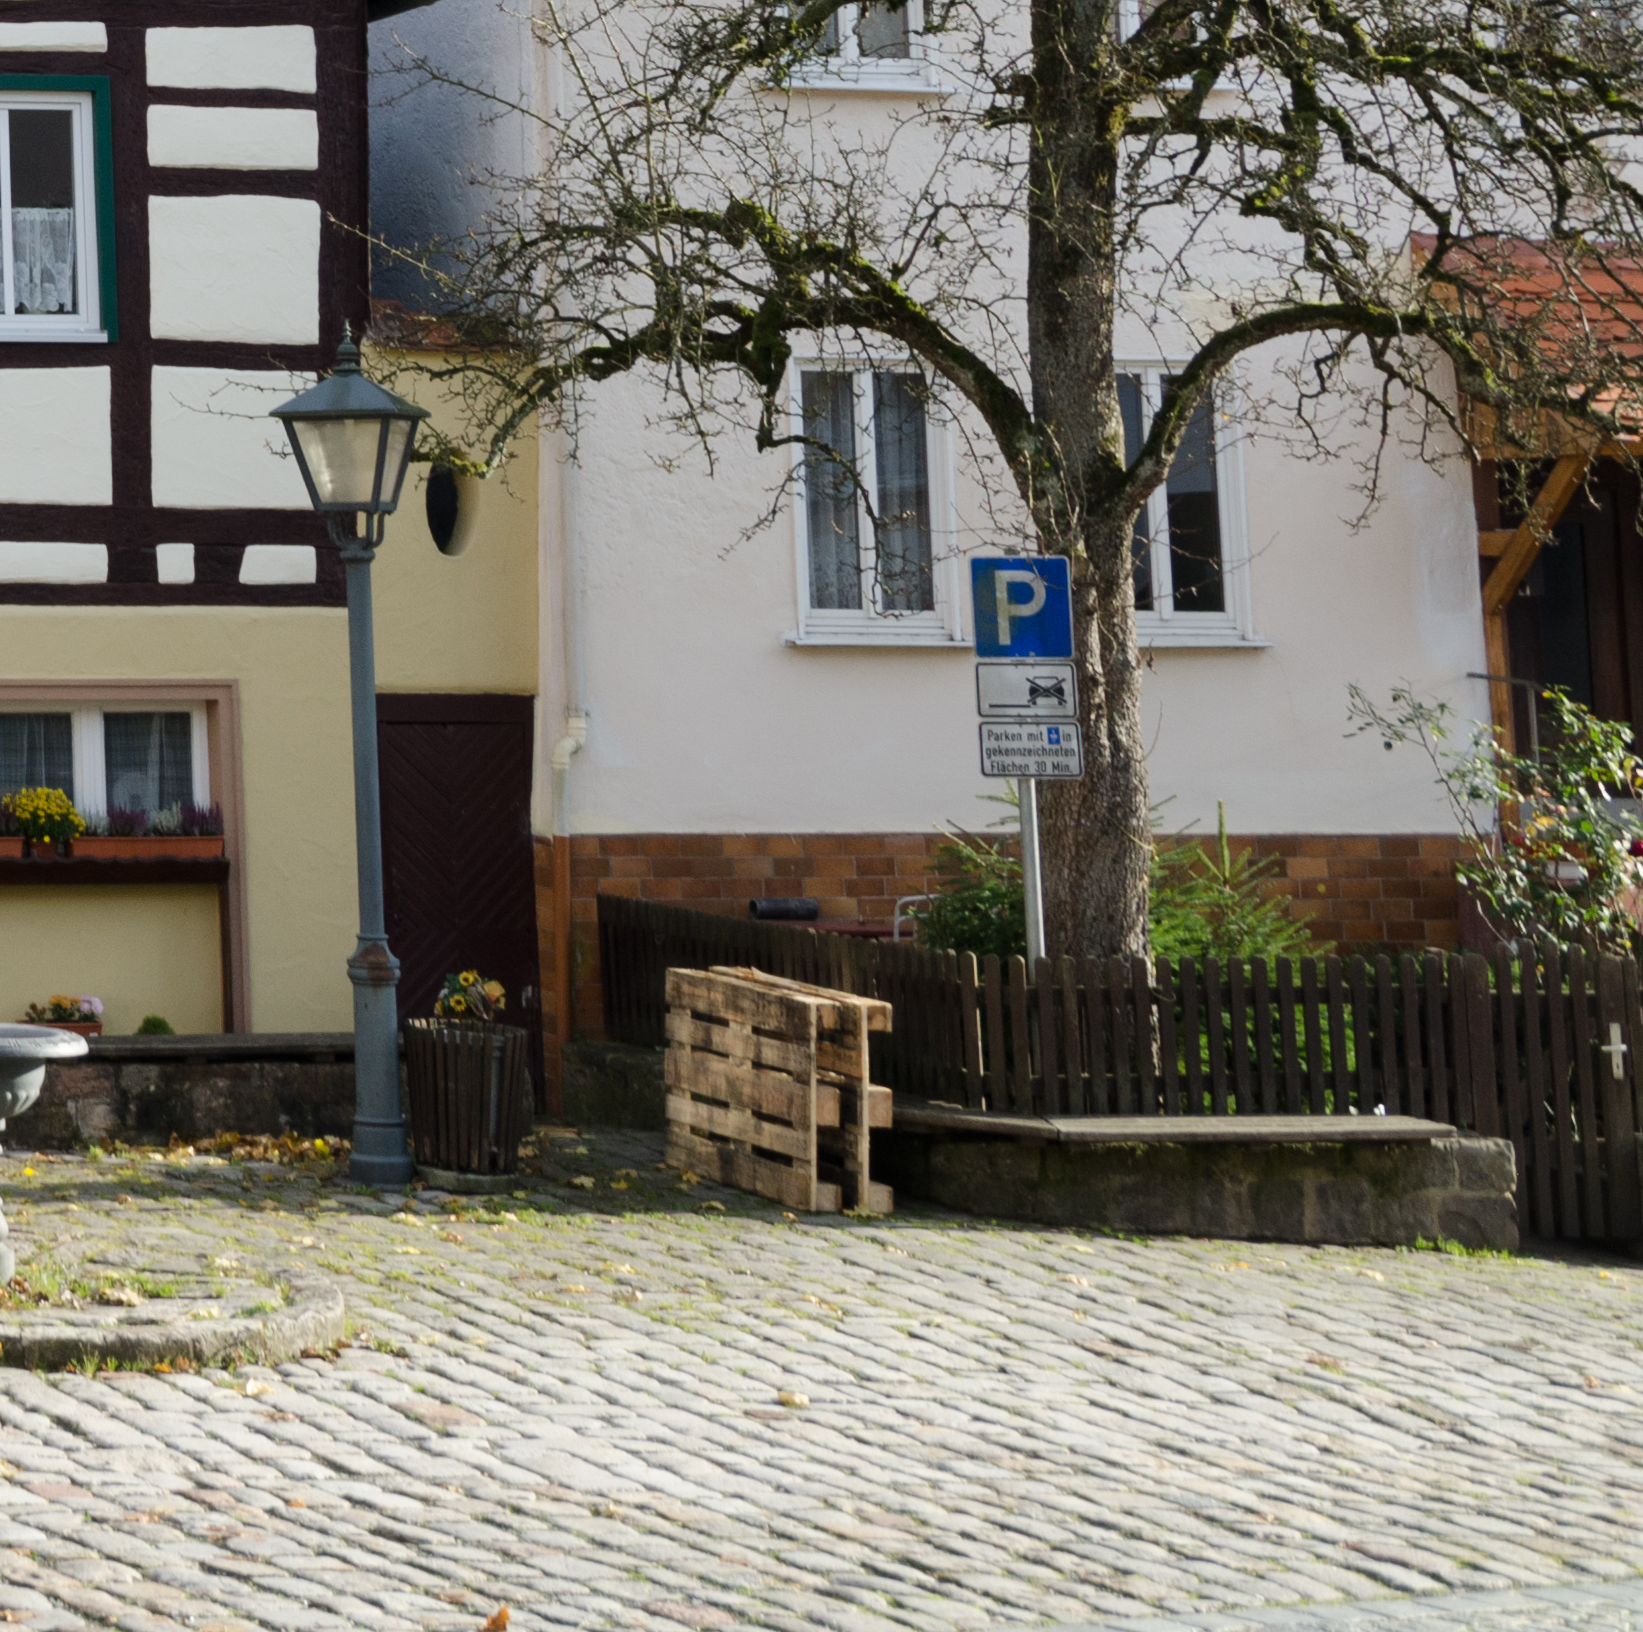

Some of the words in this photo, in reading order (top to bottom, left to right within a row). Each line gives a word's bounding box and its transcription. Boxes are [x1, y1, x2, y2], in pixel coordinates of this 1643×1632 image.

[994, 569, 1046, 646] P
[987, 729, 1023, 742] Parken
[1027, 729, 1044, 742] mit
[1062, 729, 1073, 742] in
[985, 744, 1076, 760] gekennzeichneten
[990, 759, 1031, 773] Flächen
[1034, 760, 1048, 773] 30
[1052, 760, 1074, 774] Min.
